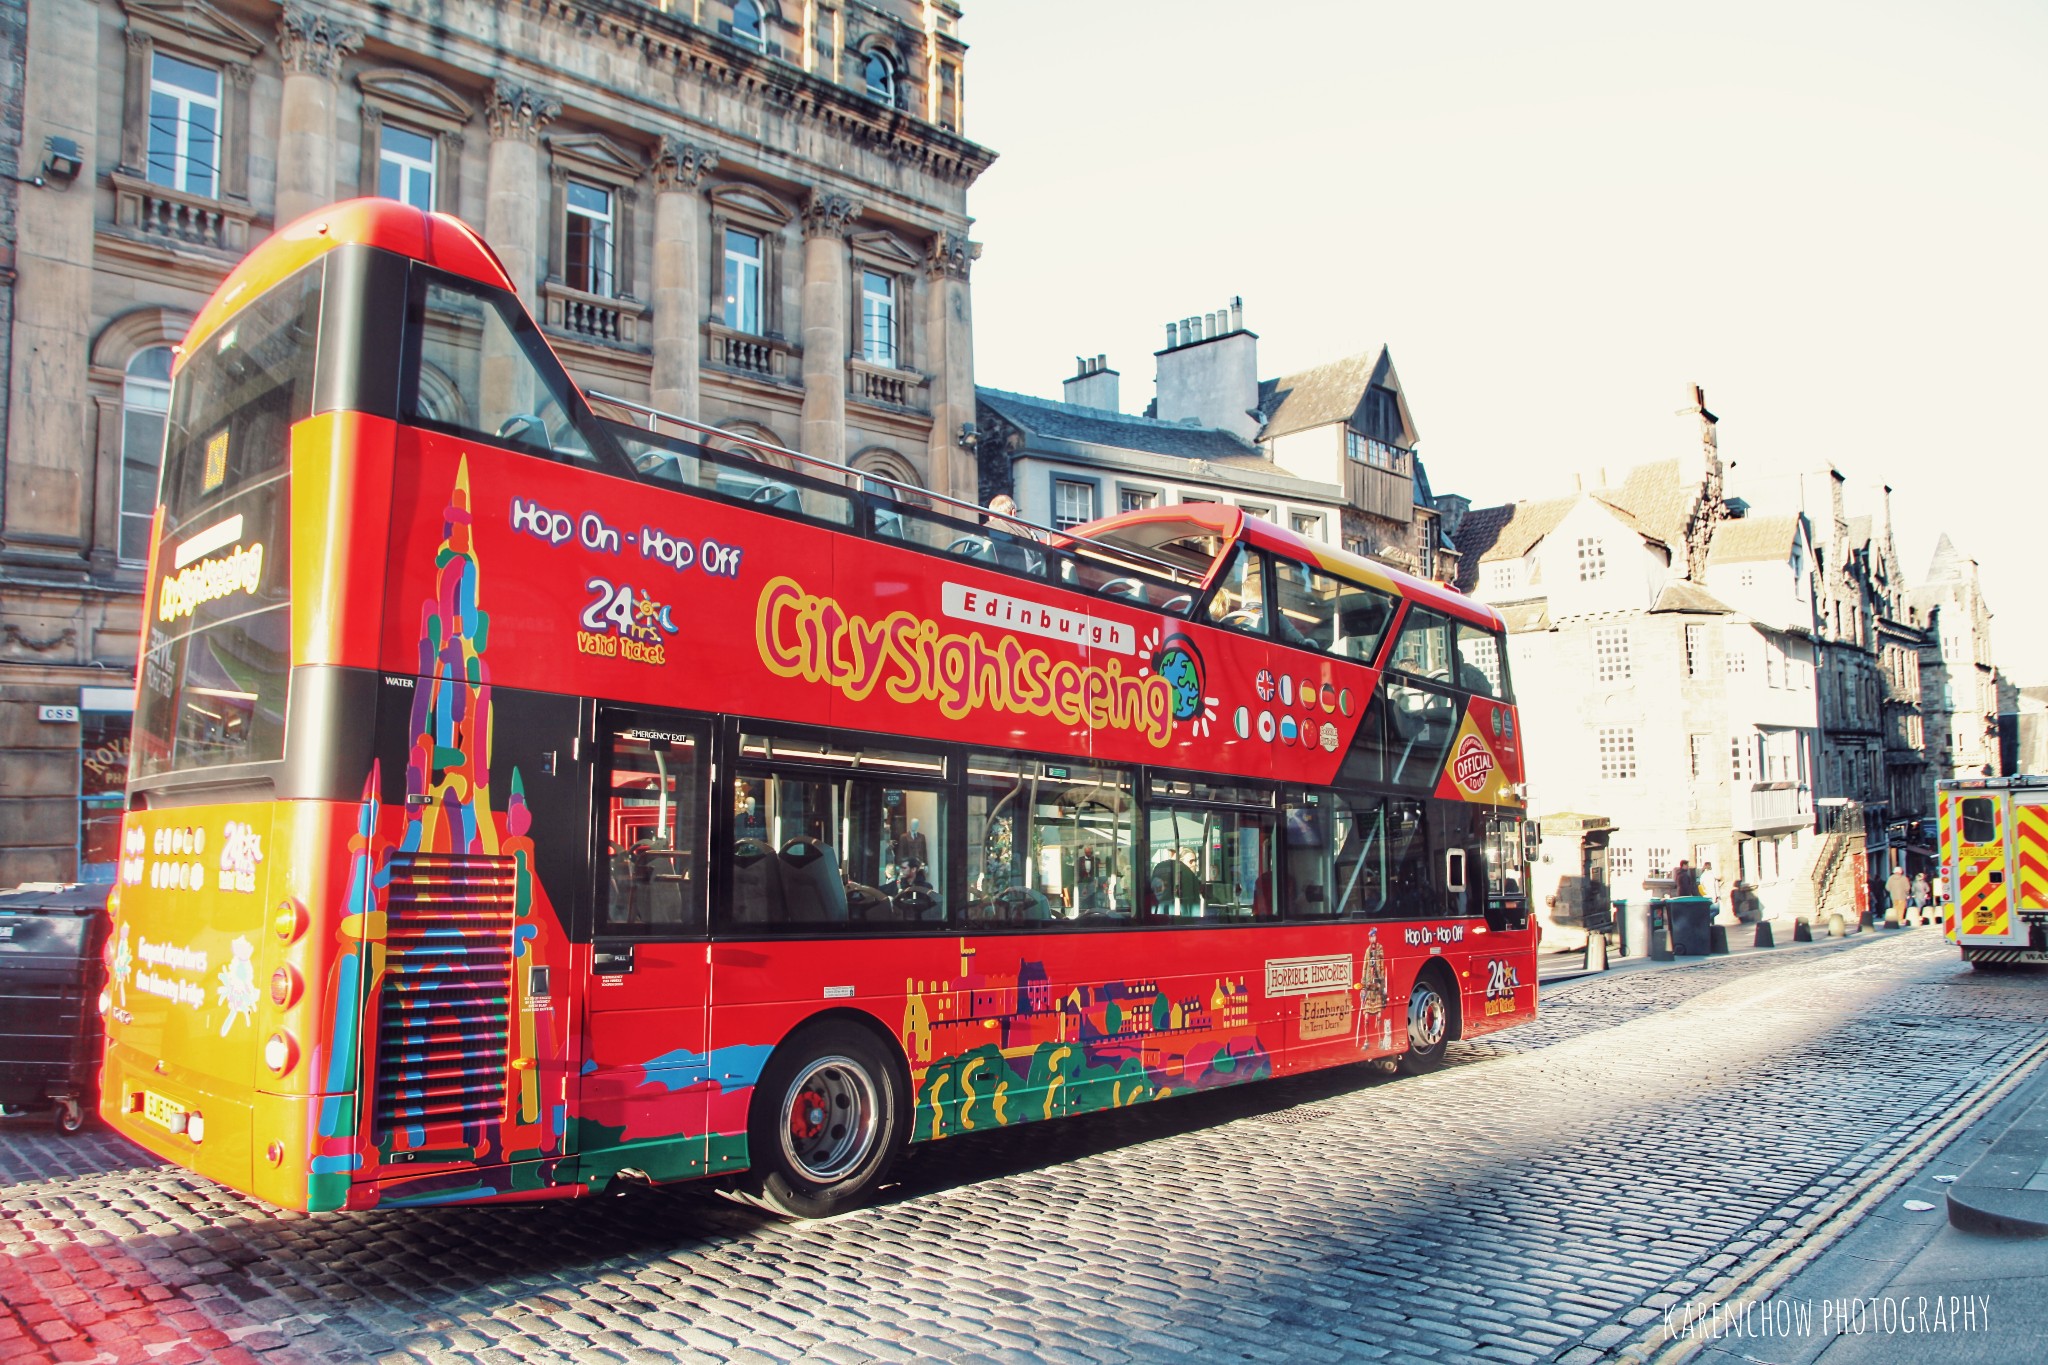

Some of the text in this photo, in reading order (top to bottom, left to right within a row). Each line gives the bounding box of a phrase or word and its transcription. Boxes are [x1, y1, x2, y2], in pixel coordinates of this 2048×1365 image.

[512, 498, 573, 545] Hop
[580, 513, 620, 554] On
[641, 527, 696, 570] Hop
[701, 540, 742, 577] Off
[582, 578, 634, 634] 24
[963, 590, 1120, 645] Edinburgh
[577, 631, 666, 665] Valid Ticket
[385, 676, 414, 688] WATER
[631, 729, 687, 742] EMERGENCY EXIT
[1457, 754, 1492, 779] OFFICIAL
[1469, 773, 1485, 789] TOUR
[1959, 847, 2003, 857] AMBULANCE
[1405, 928, 1421, 946] Hop
[1421, 926, 1433, 944] On
[1437, 926, 1451, 944] Hop
[1452, 925, 1464, 941] Off
[1271, 964, 1348, 988] HORRIBLE HISTORIES
[1486, 960, 1506, 998] 24
[1303, 1000, 1351, 1021] Edinburgh
[1310, 1022, 1324, 1034] Terry
